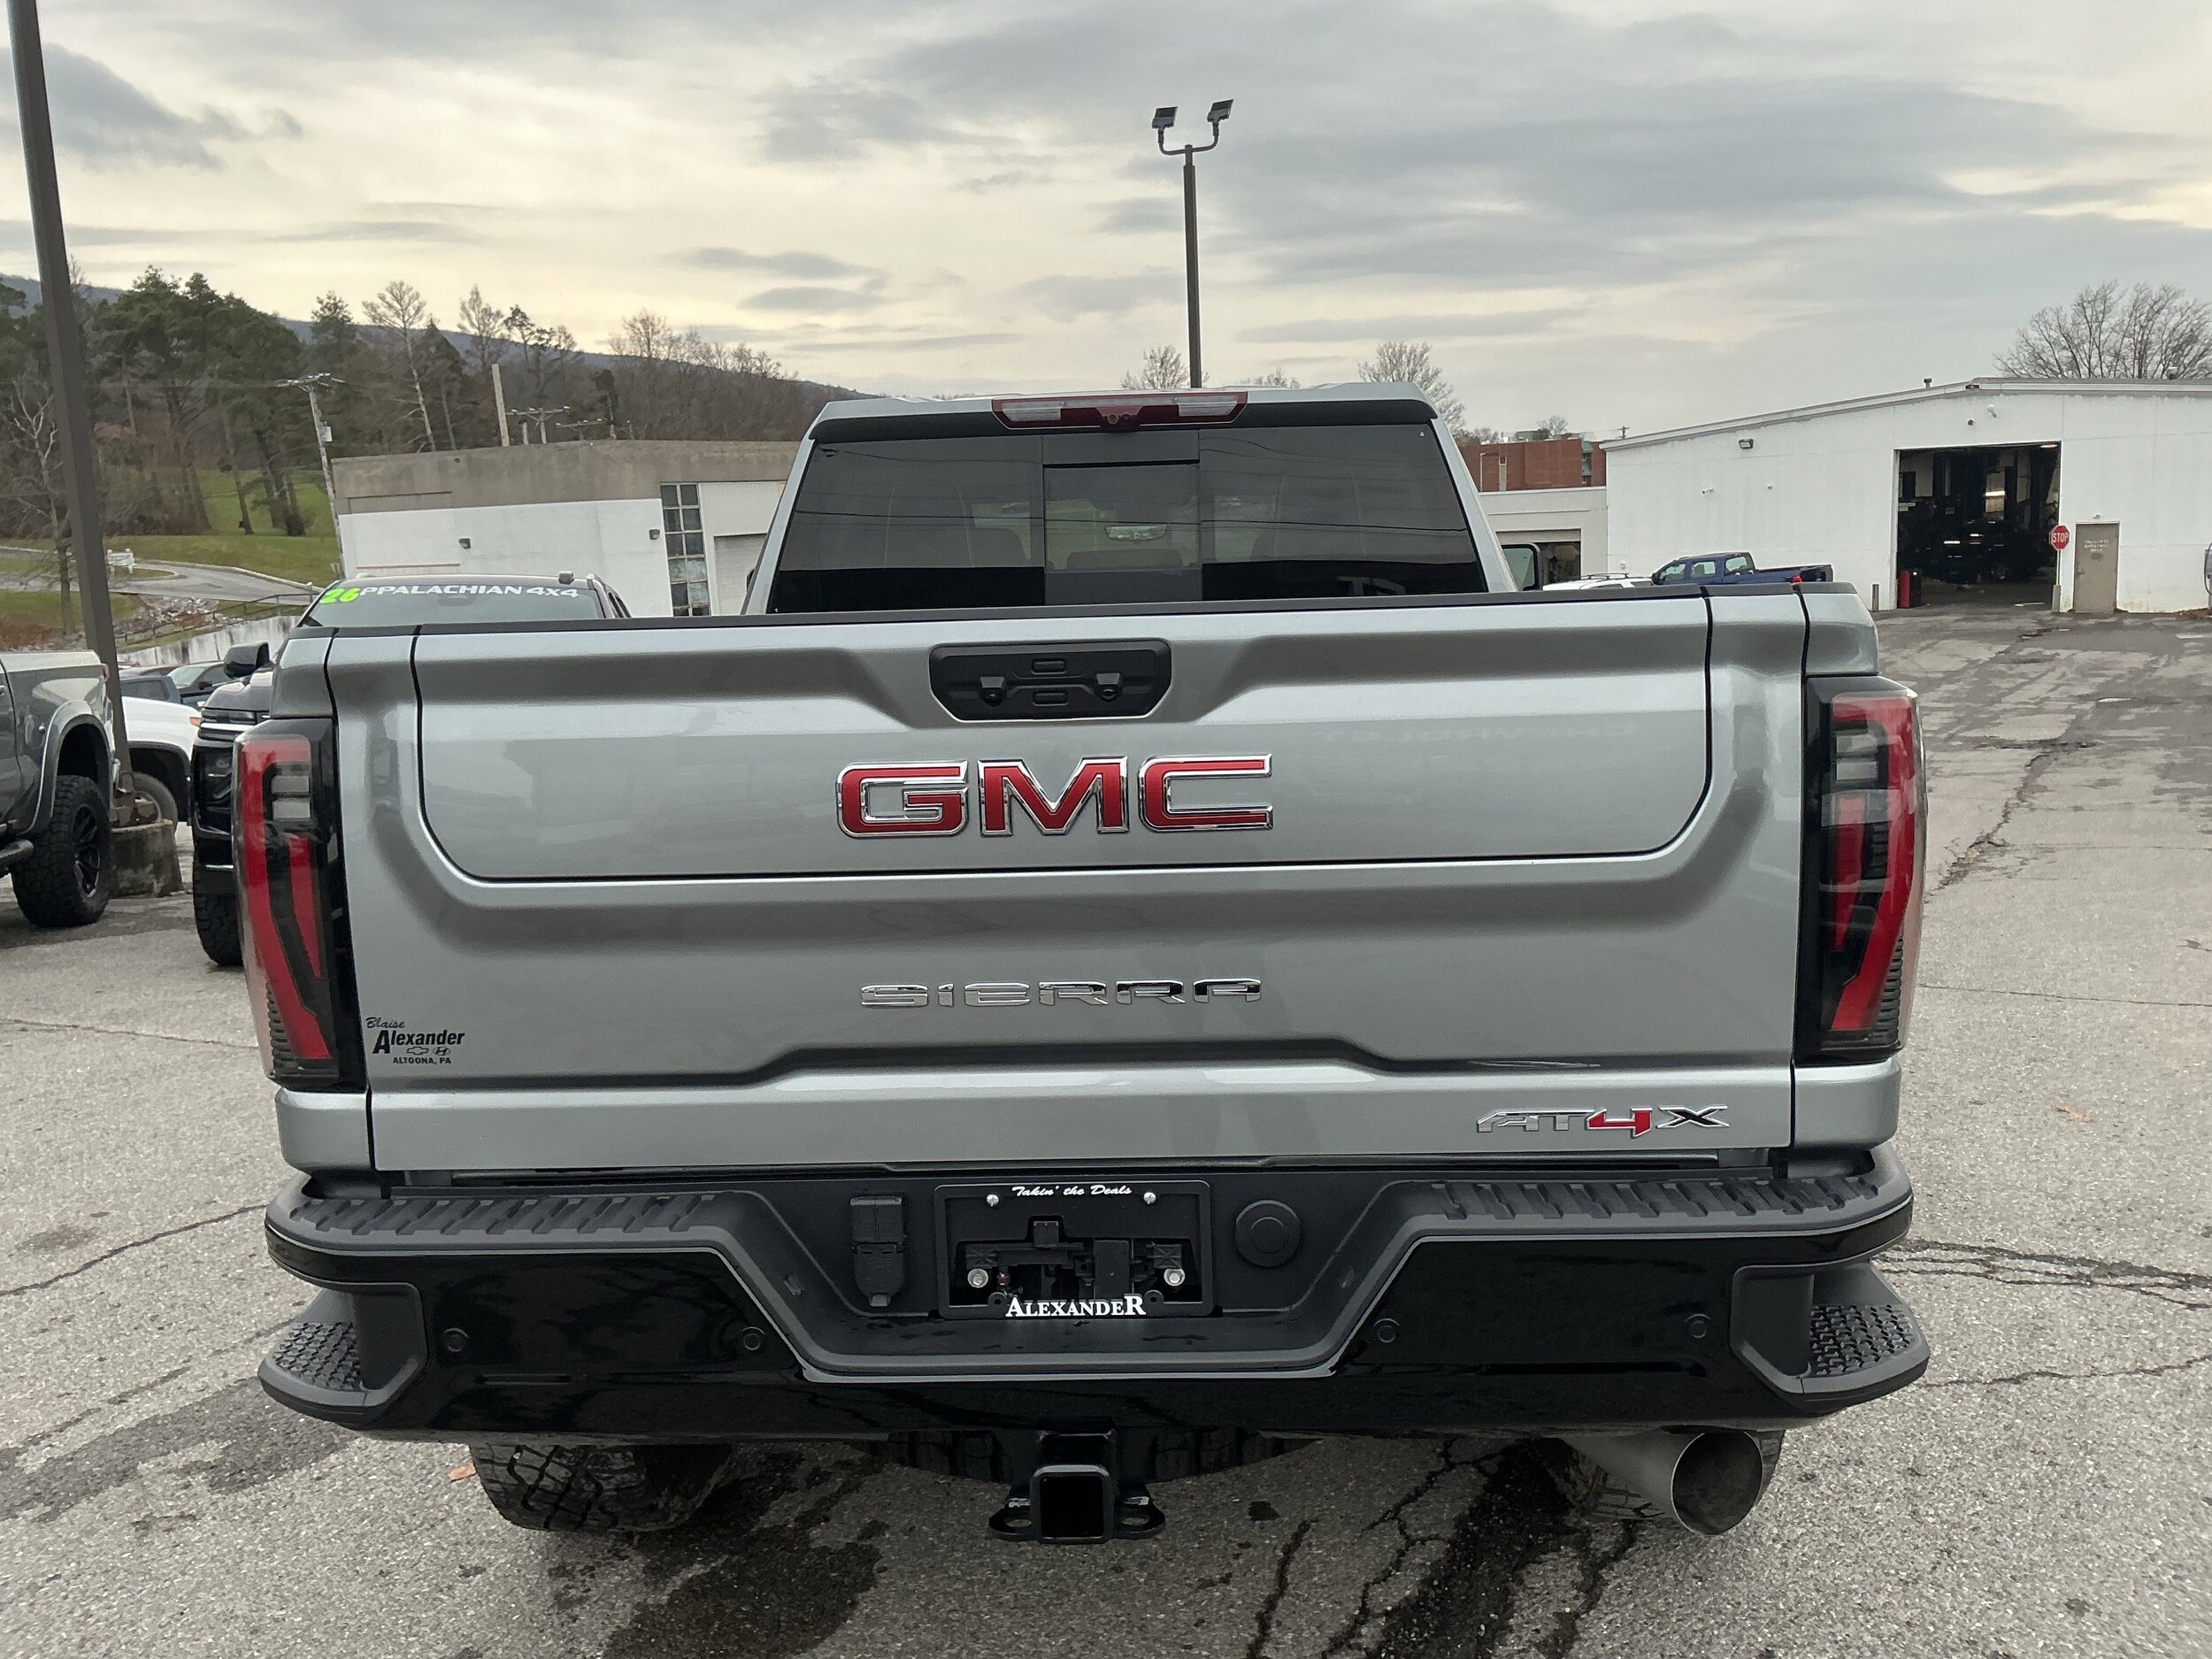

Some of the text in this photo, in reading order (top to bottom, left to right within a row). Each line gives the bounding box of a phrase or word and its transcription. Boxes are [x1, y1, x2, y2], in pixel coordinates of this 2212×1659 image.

[2053, 533, 2069, 543] STOP
[319, 588, 360, 604] 26
[359, 585, 523, 596] PPALACHIAN
[836, 754, 1273, 838] GMC
[861, 978, 1262, 1009] SIERRA
[365, 1017, 405, 1029] Blaise
[373, 1029, 465, 1054] Alexander
[392, 1056, 437, 1065] ALTOONA,
[1477, 1105, 1729, 1139] AT4X
[1011, 1184, 1132, 1196] Takin' the Deals
